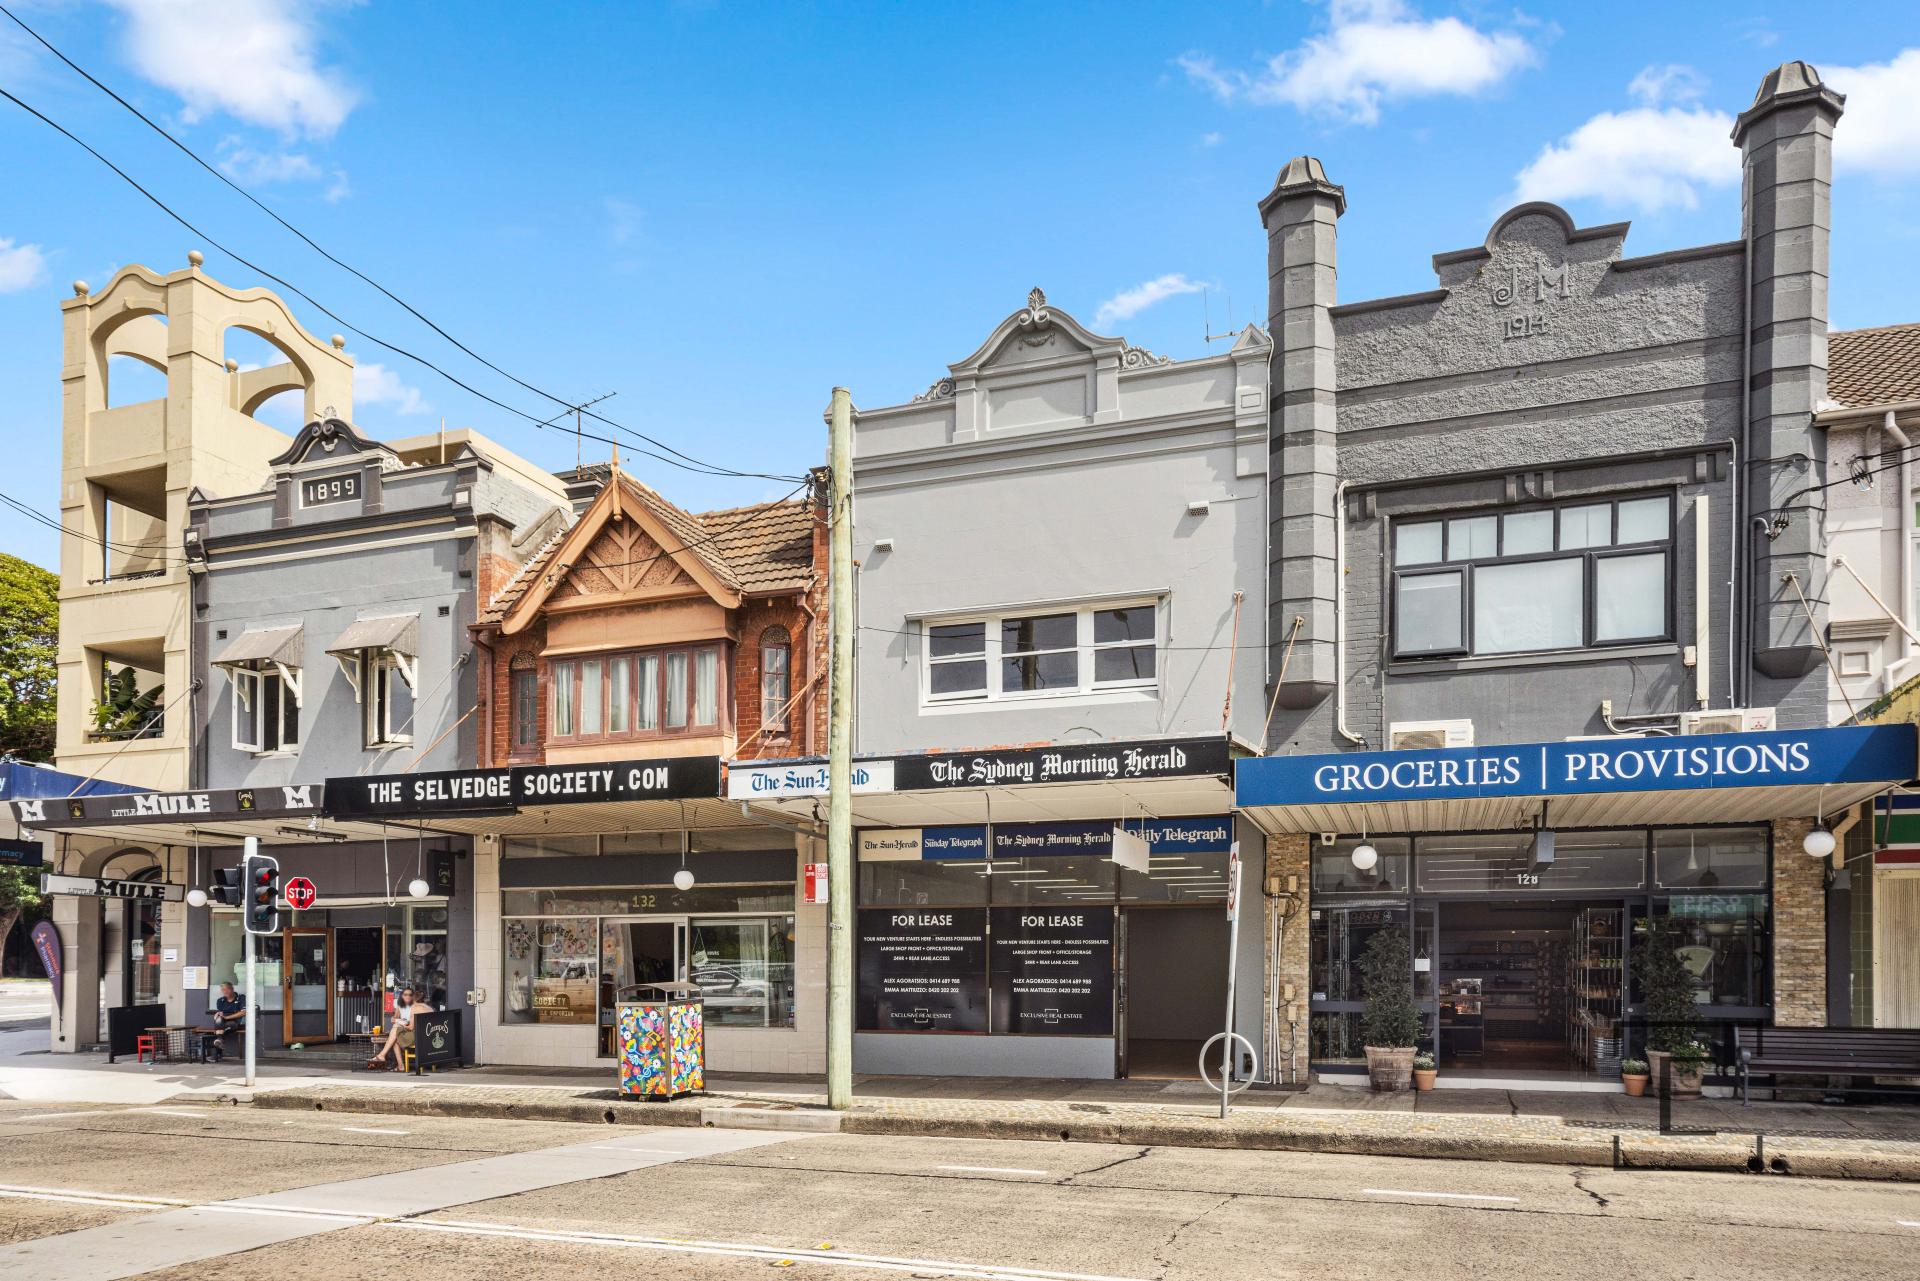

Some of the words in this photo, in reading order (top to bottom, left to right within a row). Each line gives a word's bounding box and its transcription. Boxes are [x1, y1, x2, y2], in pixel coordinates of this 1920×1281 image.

[1504, 314, 1550, 340] 1914
[310, 479, 354, 502] 1899
[929, 760, 965, 786] The
[968, 758, 1034, 784] Sydney
[1040, 754, 1119, 780] Morning
[1123, 746, 1187, 777] Herald
[1314, 757, 1520, 791] GROCERIES
[1565, 742, 1810, 781] PROVISIONS
[368, 782, 402, 803] THE
[414, 776, 510, 800] SELVEDGE
[524, 768, 668, 796] SOCIETY.COM
[752, 773, 780, 792] The
[112, 808, 136, 816] LITTLE
[134, 794, 210, 816] MULE
[282, 786, 314, 809] M
[18, 800, 46, 822] M
[924, 838, 948, 848] Sunday
[950, 838, 982, 848] Telegraph
[996, 834, 1012, 846] The
[1015, 835, 1044, 847] Sydney
[1046, 834, 1082, 846] Morning
[1083, 832, 1110, 844] Herald
[1163, 826, 1226, 842] Telegraph
[864, 840, 878, 850] The
[880, 840, 918, 850] Sun-Herald
[95, 880, 166, 899] MULE
[288, 887, 312, 900] STOP
[632, 895, 656, 908] 132
[892, 916, 915, 926] FOR
[918, 915, 952, 926] LEASE
[1022, 916, 1044, 926] FOR
[1048, 916, 1084, 926] LEASE
[534, 996, 567, 1006] SOCIETY
